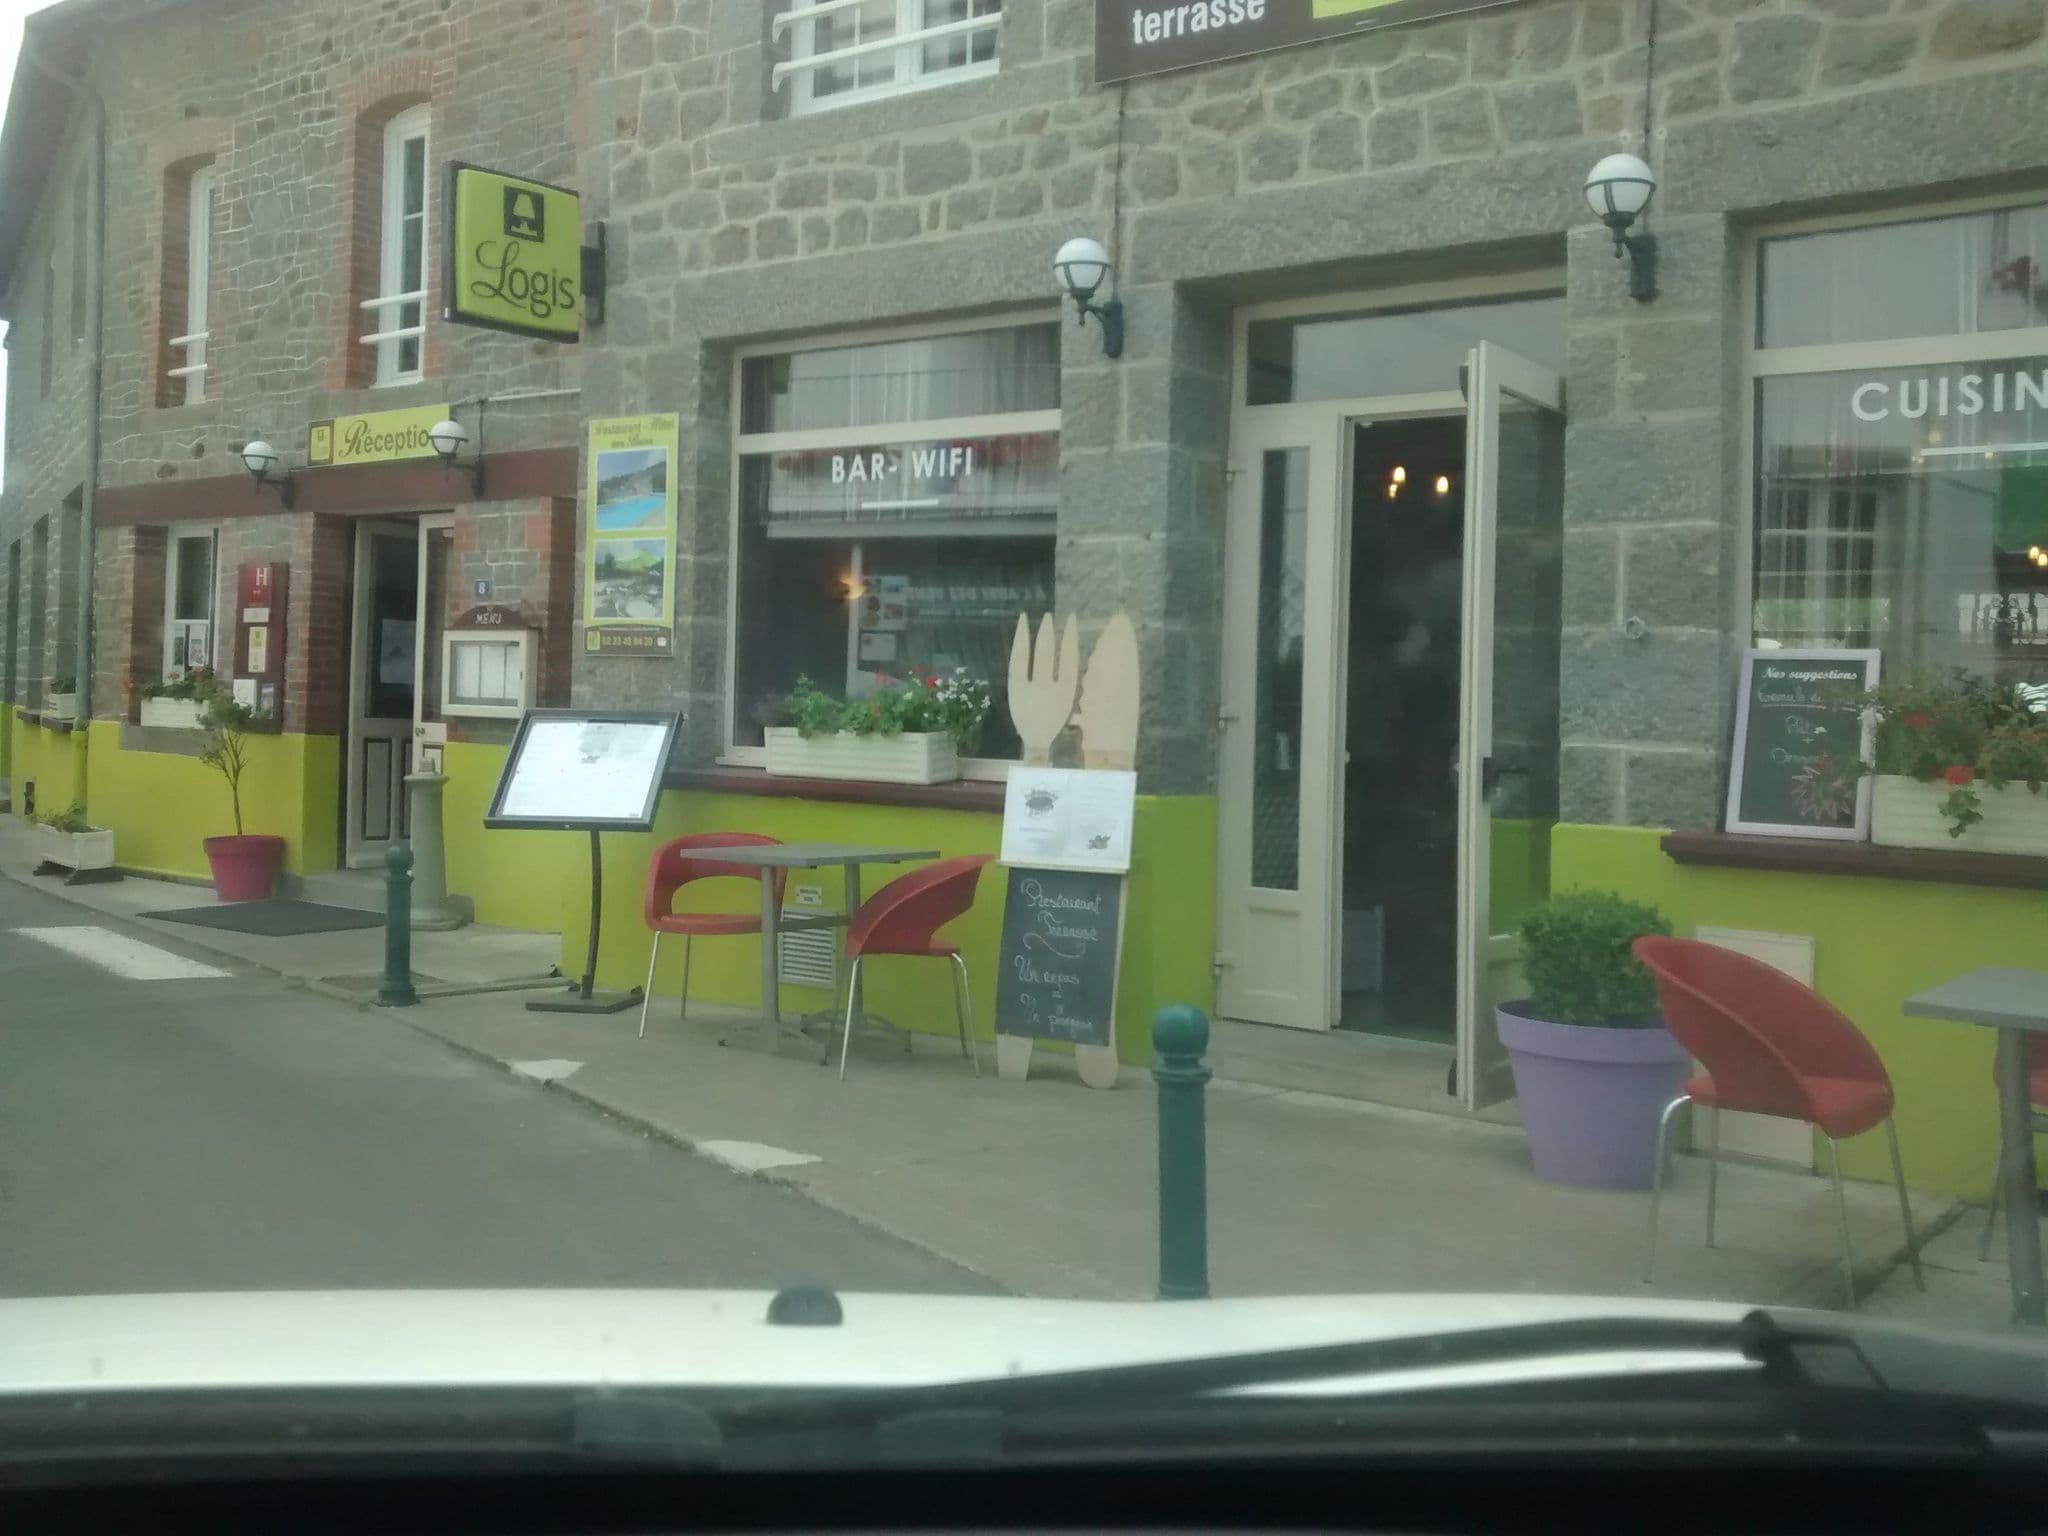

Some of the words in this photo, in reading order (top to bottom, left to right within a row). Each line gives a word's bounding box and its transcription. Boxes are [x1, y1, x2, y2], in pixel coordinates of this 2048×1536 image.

[1132, 0, 1265, 44] terrasse
[470, 240, 575, 318] Logis
[338, 420, 431, 457] Réceptio
[912, 446, 973, 479] WIFI
[255, 567, 268, 586] H
[478, 582, 487, 594] 8
[475, 612, 503, 625] MENU
[1761, 667, 1786, 679] Nos
[1789, 669, 1858, 682] suggestions
[1020, 878, 1102, 915] Restaurant
